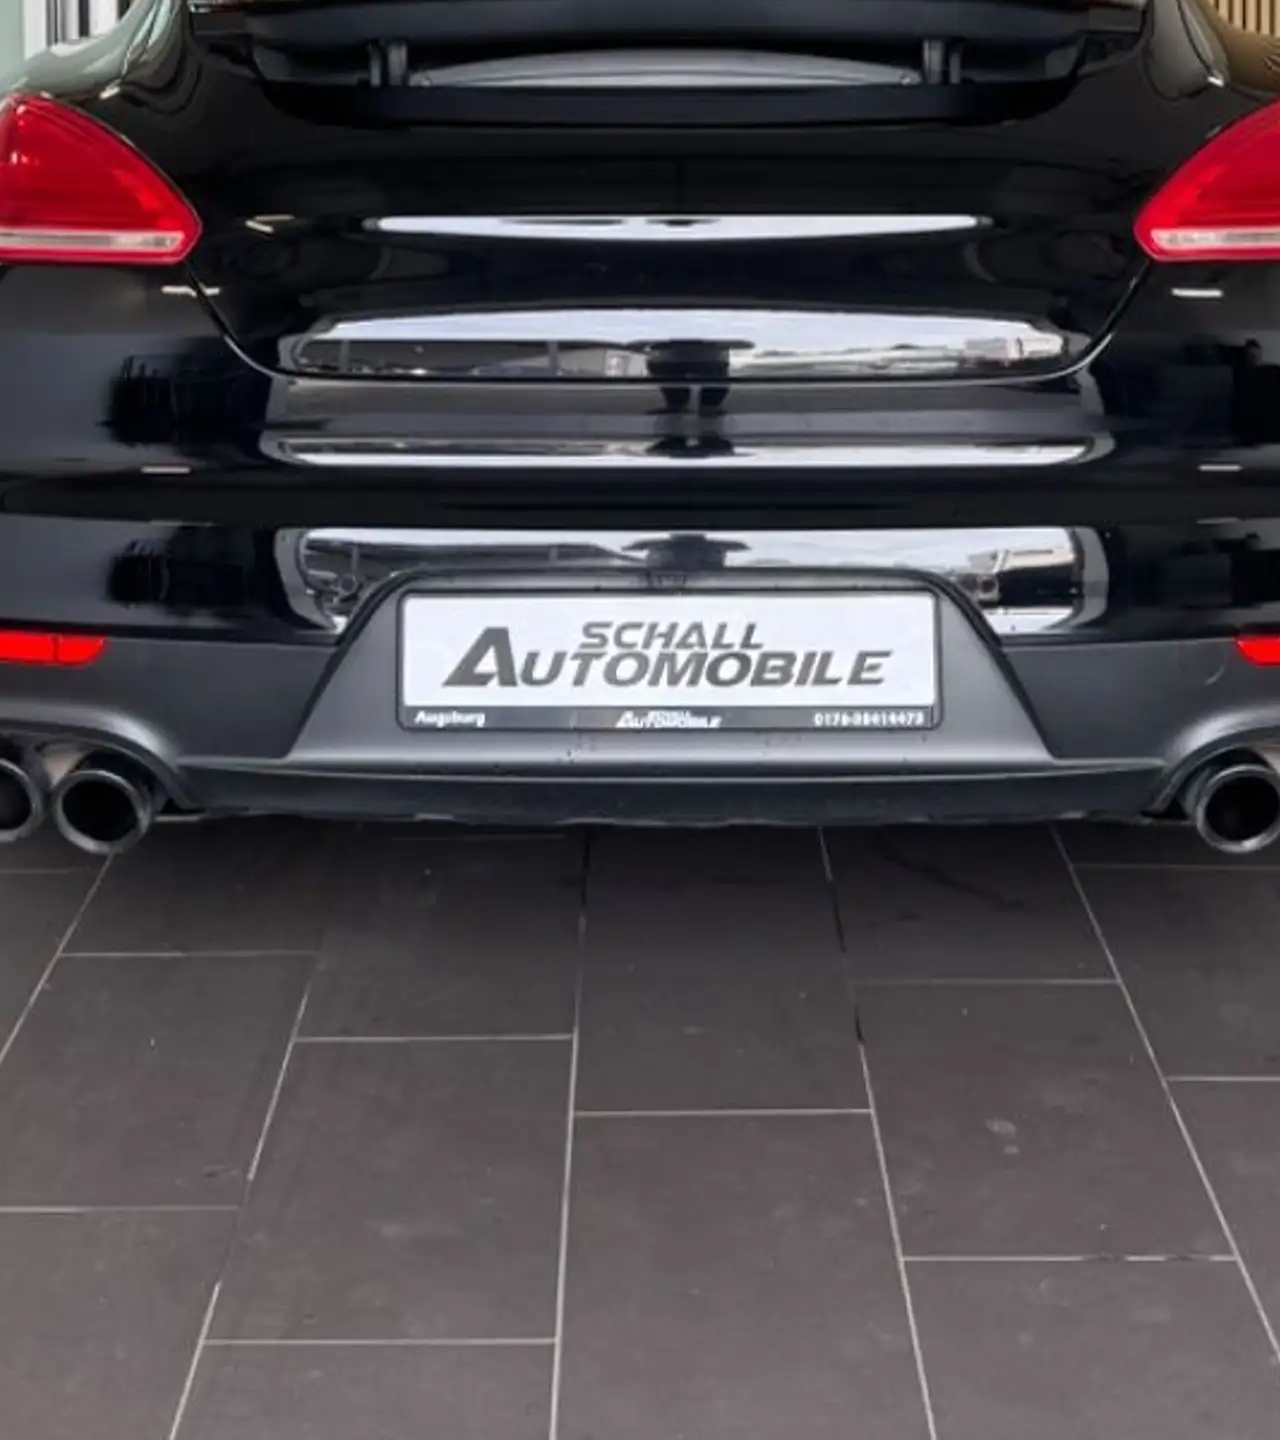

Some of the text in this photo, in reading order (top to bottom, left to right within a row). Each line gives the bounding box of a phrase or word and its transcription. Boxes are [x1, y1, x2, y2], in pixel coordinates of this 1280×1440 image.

[580, 622, 762, 650] SCHALL
[443, 626, 892, 688] AUTOMOBILE
[414, 710, 486, 728] Augsburg
